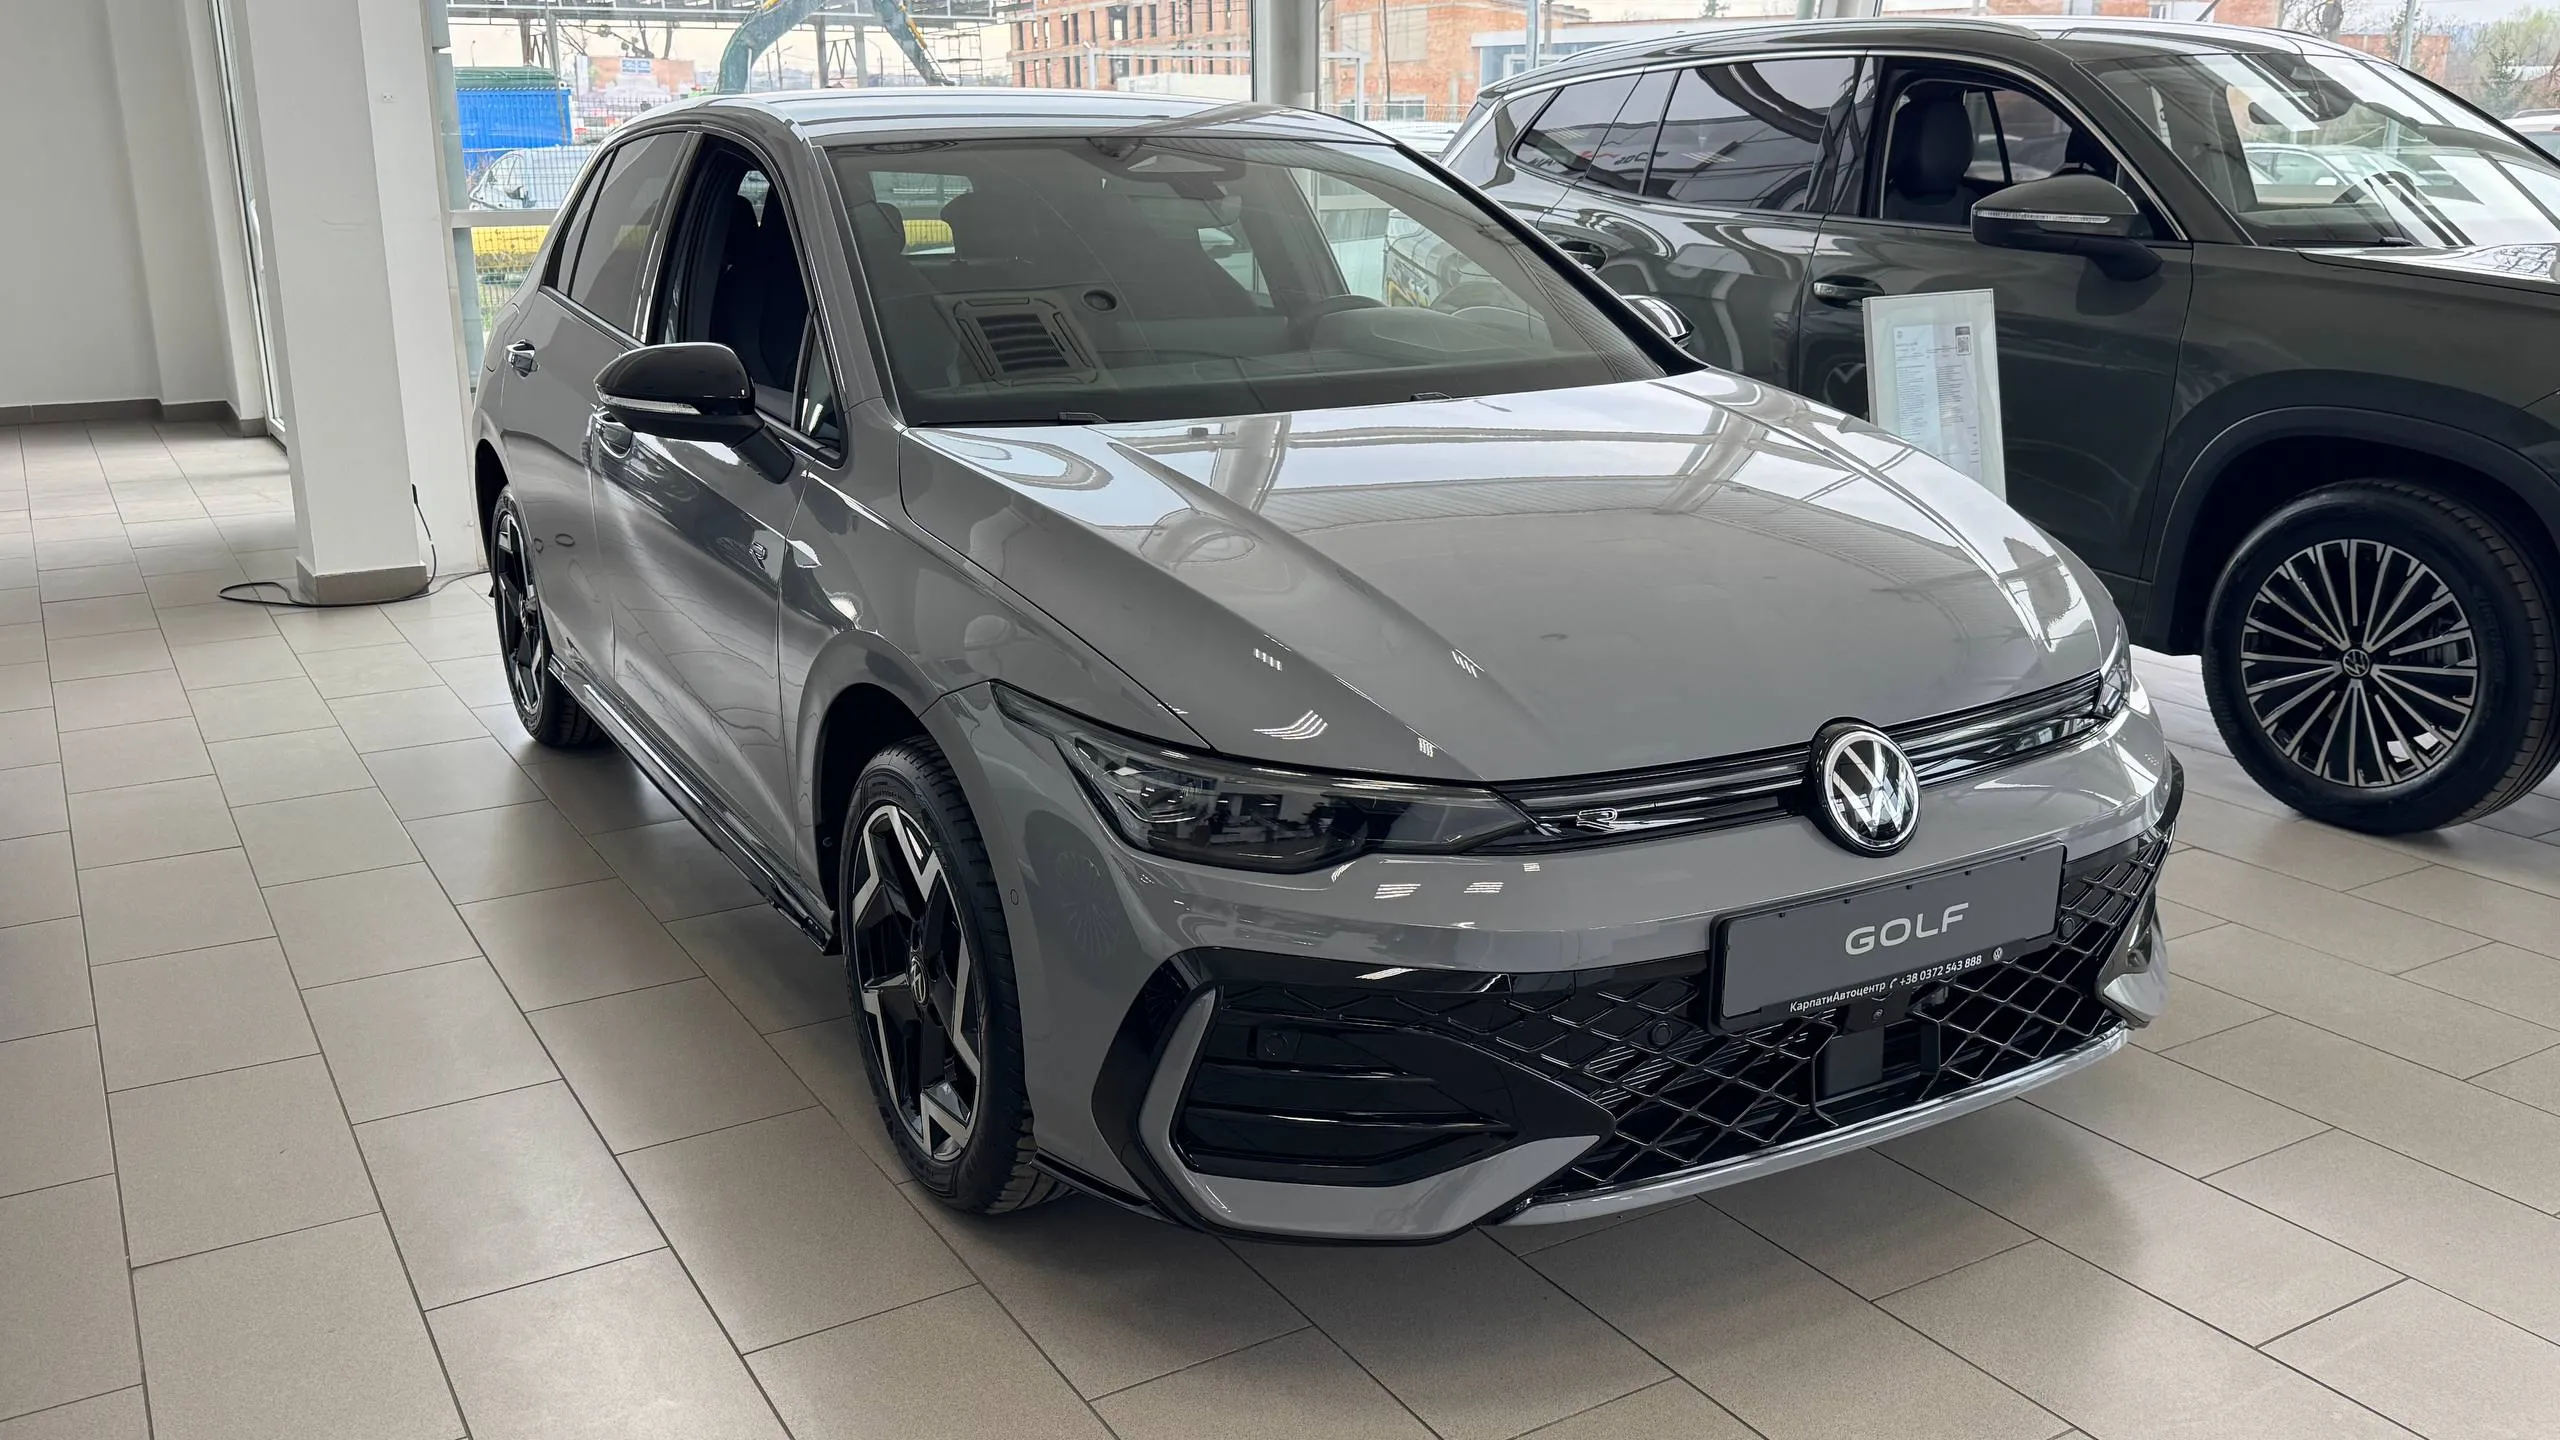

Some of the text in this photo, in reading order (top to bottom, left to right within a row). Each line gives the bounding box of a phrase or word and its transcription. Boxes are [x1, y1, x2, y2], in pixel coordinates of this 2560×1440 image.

[1845, 903, 1969, 955] GOLF
[1789, 954, 1982, 1013] КарпатиАвтоцентр +38 0372 543 888
